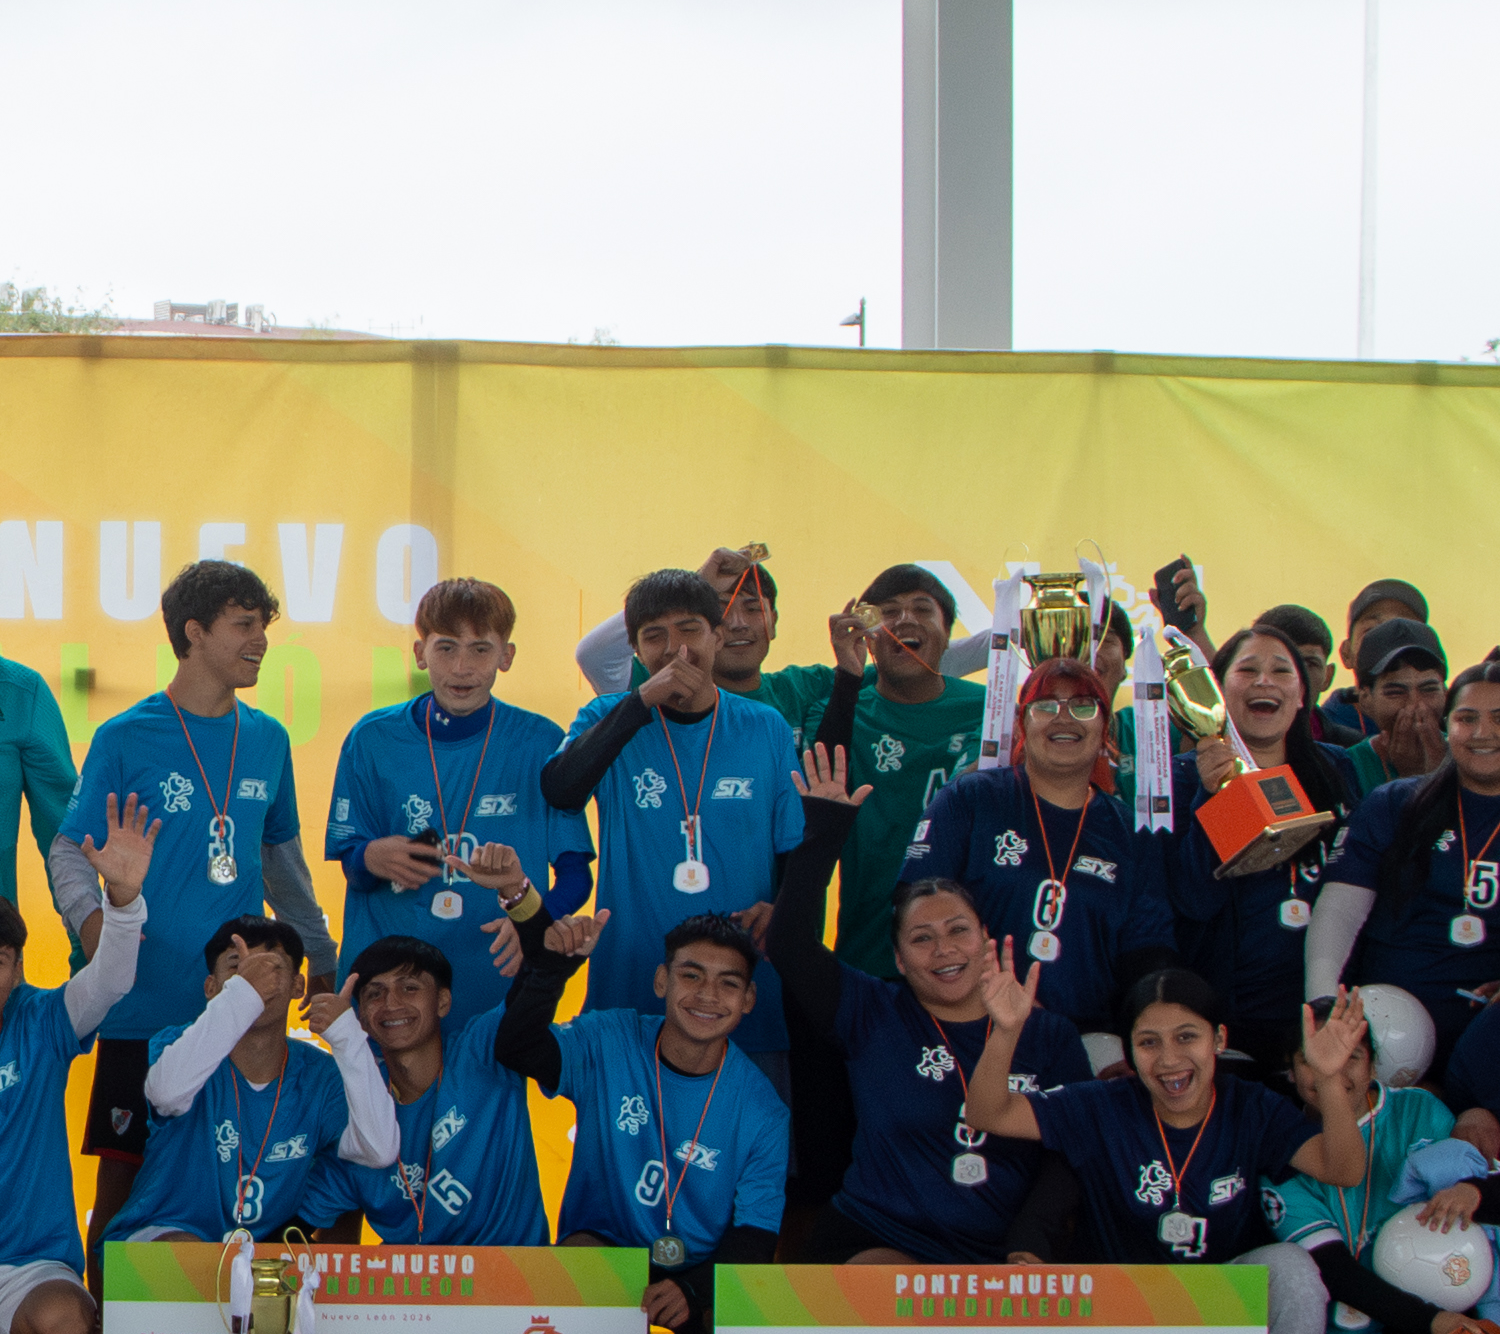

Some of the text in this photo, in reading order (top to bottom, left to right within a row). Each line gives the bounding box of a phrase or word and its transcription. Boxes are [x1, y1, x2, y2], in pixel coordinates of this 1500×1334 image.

[236, 777, 268, 801] SIX
[711, 777, 754, 799] SIX
[473, 792, 516, 817] SIX
[206, 815, 236, 869] 3
[1072, 854, 1117, 883] SIX
[1467, 861, 1500, 910] 5
[431, 1105, 468, 1152] SIX
[265, 1134, 309, 1163] SIX
[427, 1167, 472, 1216] 5
[635, 1159, 669, 1208] 9
[392, 1254, 475, 1274] NUEVO
[896, 1274, 1093, 1295] PONTE NUEVO
